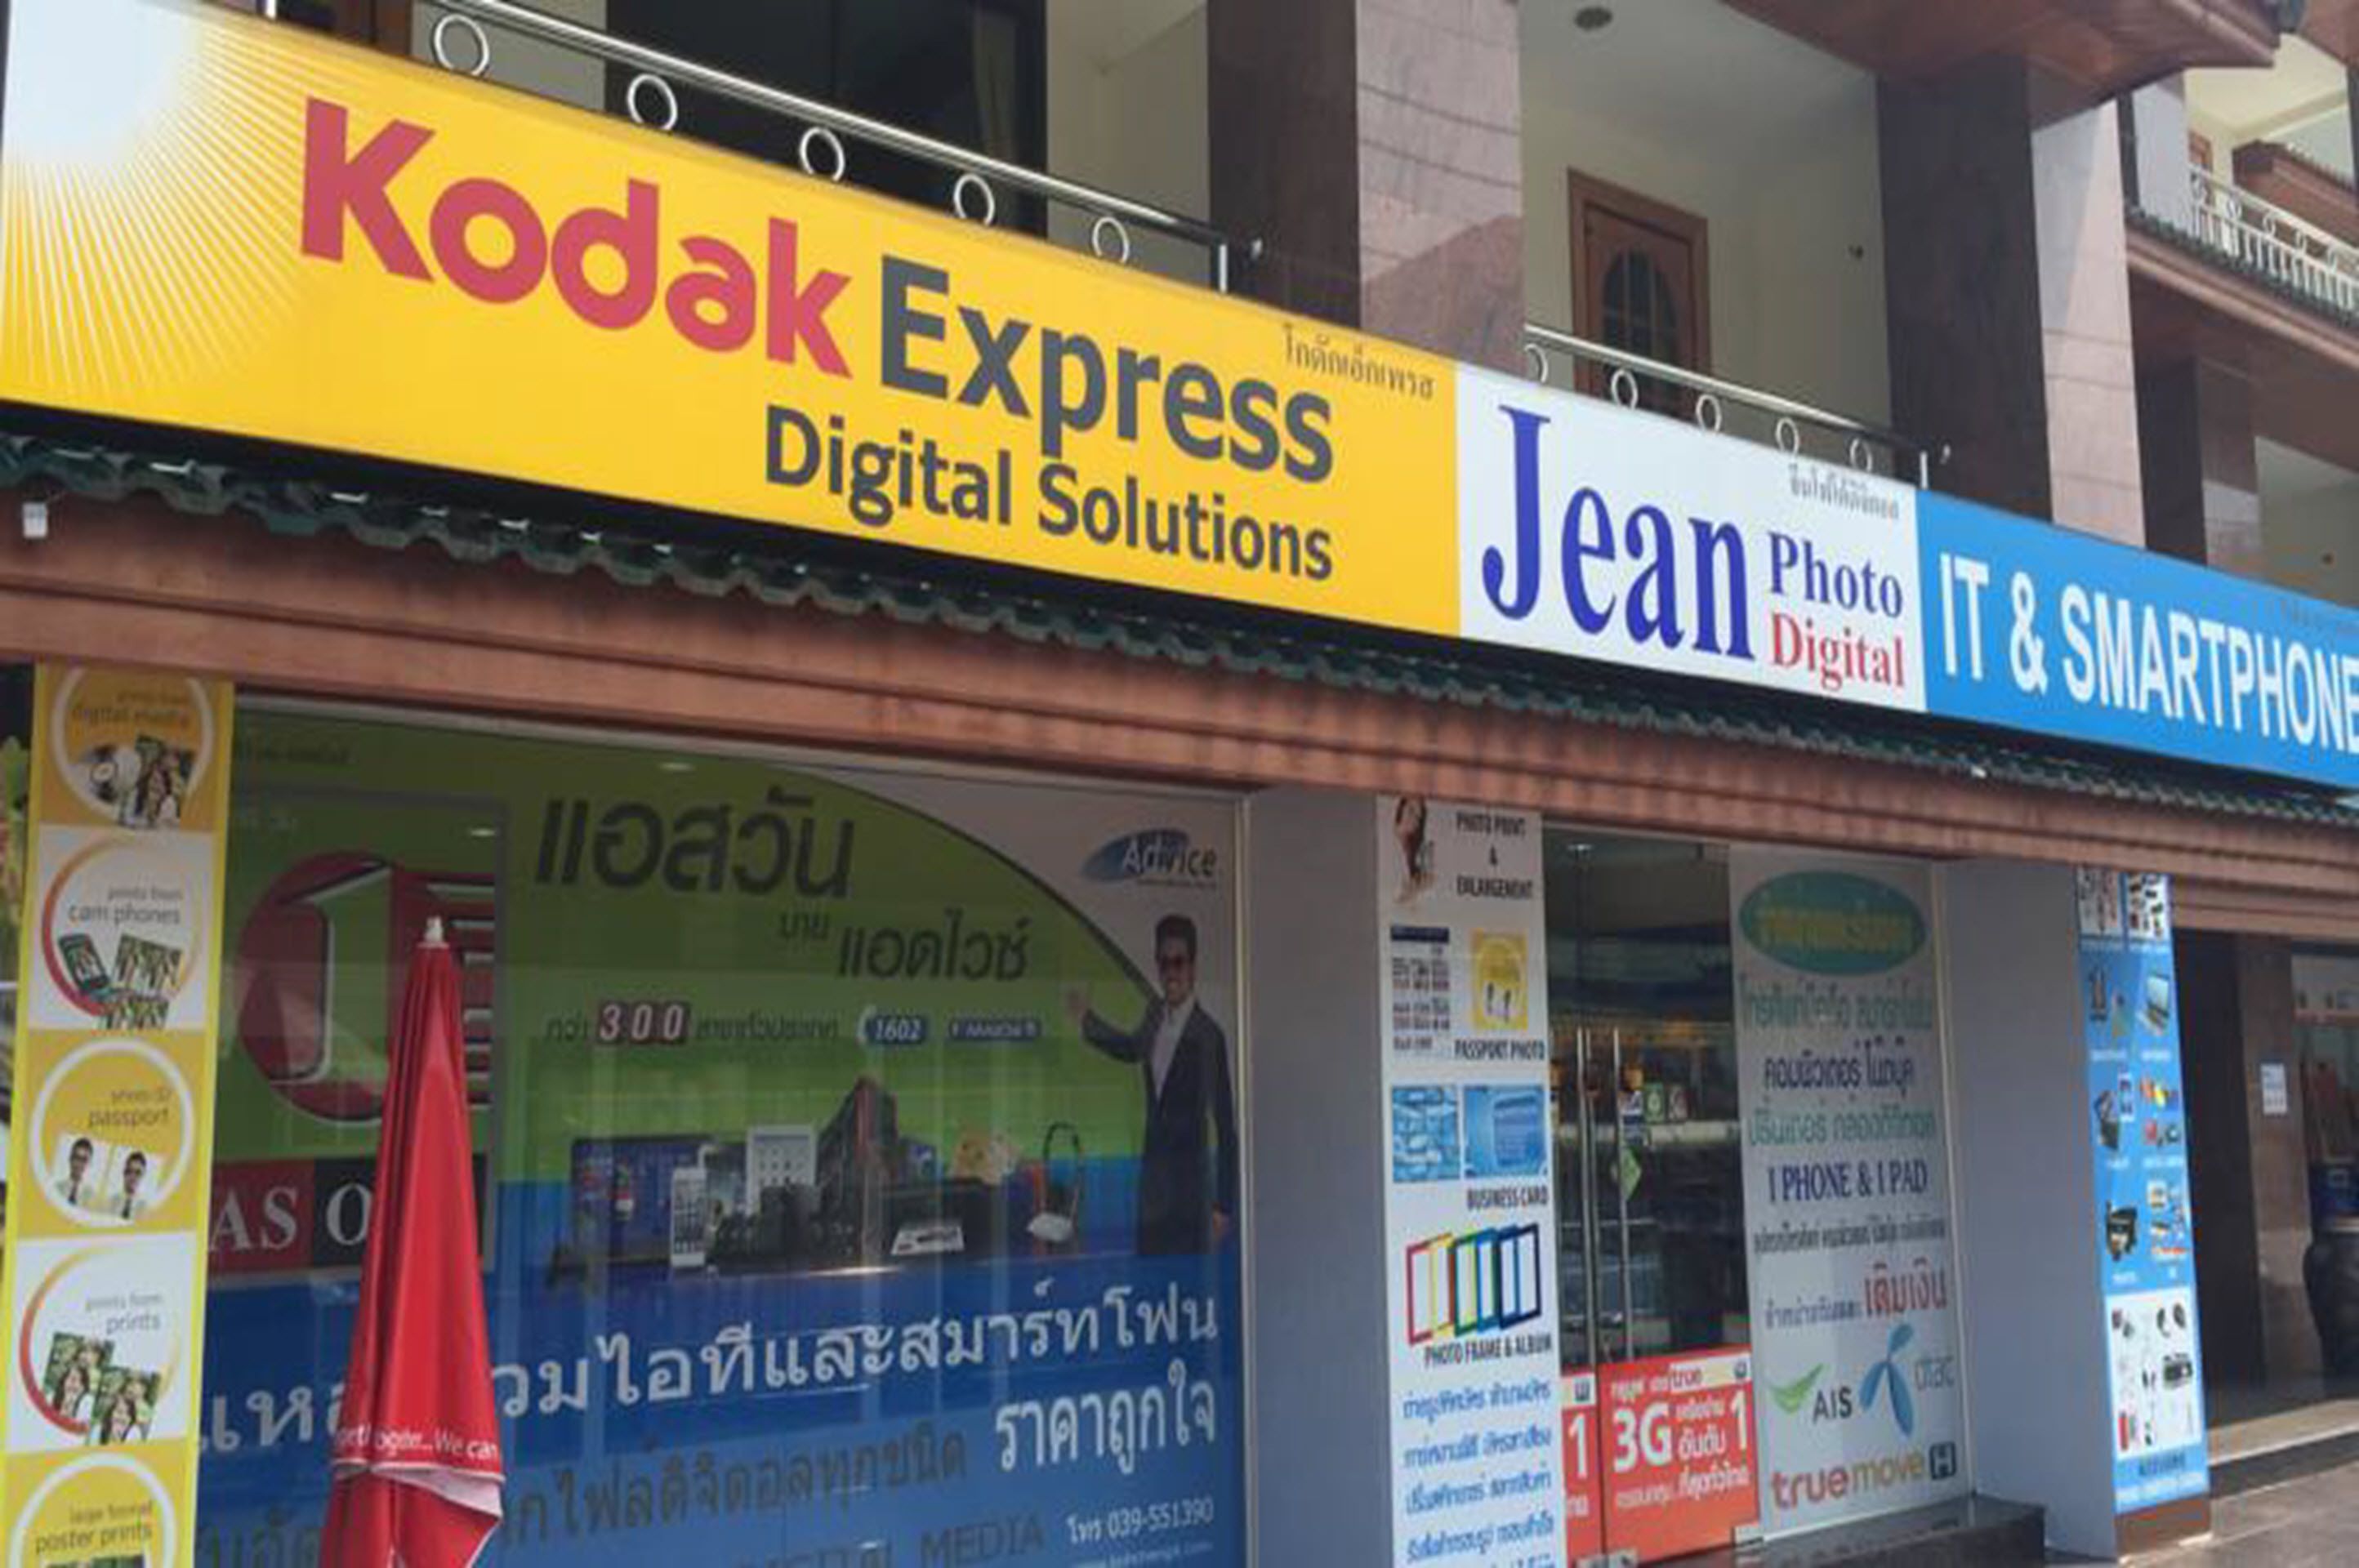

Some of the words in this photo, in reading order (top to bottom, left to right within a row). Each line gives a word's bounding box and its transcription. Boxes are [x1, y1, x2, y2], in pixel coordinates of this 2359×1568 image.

[300, 96, 853, 378] Kodak
[881, 255, 1334, 482] Express
[765, 405, 1012, 527] Digital
[1038, 462, 1334, 581] Solutions
[1483, 404, 1755, 661] Jean
[1768, 531, 1904, 618] Photo
[1772, 611, 1905, 692] Digital
[1939, 552, 1990, 680] IT
[2009, 571, 2049, 695] &
[2060, 584, 2359, 755] SMARTPHONE
[1122, 835, 1217, 877] Advice
[114, 902, 181, 927] phones
[598, 1003, 686, 1043] 300
[87, 1105, 170, 1129] passport
[1467, 1187, 1519, 1211] BUSINESS
[1521, 1185, 1549, 1205] CARD
[1782, 1162, 1852, 1202] PHONE
[1857, 1163, 1874, 1196] &
[1890, 1158, 1928, 1196] PAD
[1863, 1257, 1947, 1316] เติมเงิน
[105, 1312, 161, 1336] prints
[1425, 1343, 1462, 1368] PHOTO
[1465, 1338, 1501, 1363] FRAME
[1515, 1333, 1551, 1355] ALBUM
[996, 1359, 1215, 1474] ราคาถูกใจ
[1730, 1389, 1747, 1451] 1
[1813, 1388, 1853, 1425] AIS
[1613, 1401, 1673, 1473] 3G
[1772, 1447, 1925, 1509] truemove
[34, 1526, 96, 1554] poster
[100, 1521, 153, 1548] prints
